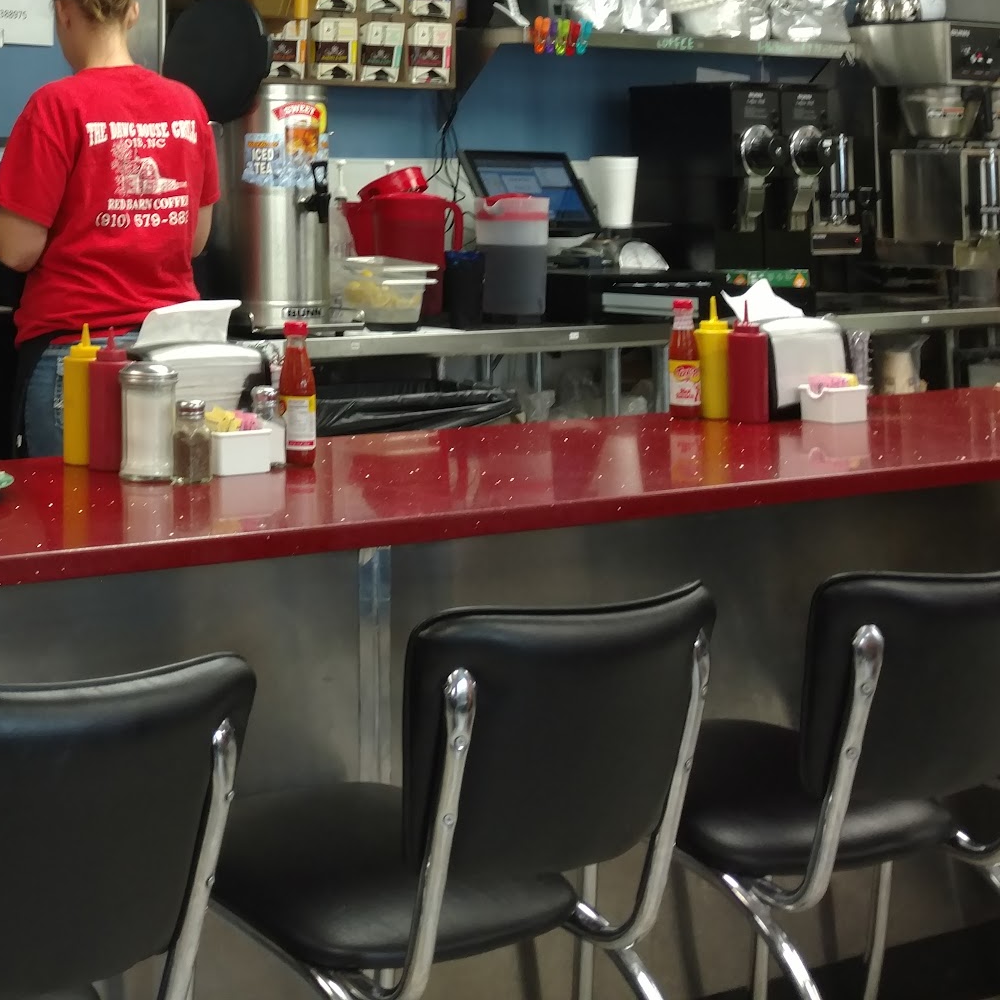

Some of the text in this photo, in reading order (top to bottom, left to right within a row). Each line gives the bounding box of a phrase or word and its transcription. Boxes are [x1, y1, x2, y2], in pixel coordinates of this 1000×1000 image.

[283, 104, 315, 115] SWEET
[85, 120, 197, 147] THE DAWG HOUSE GRILL
[148, 138, 166, 149] NC
[252, 147, 274, 161] ICED
[254, 161, 273, 175] TEA
[108, 198, 126, 210] RED
[127, 198, 153, 210] BARN
[95, 212, 131, 229] (910)
